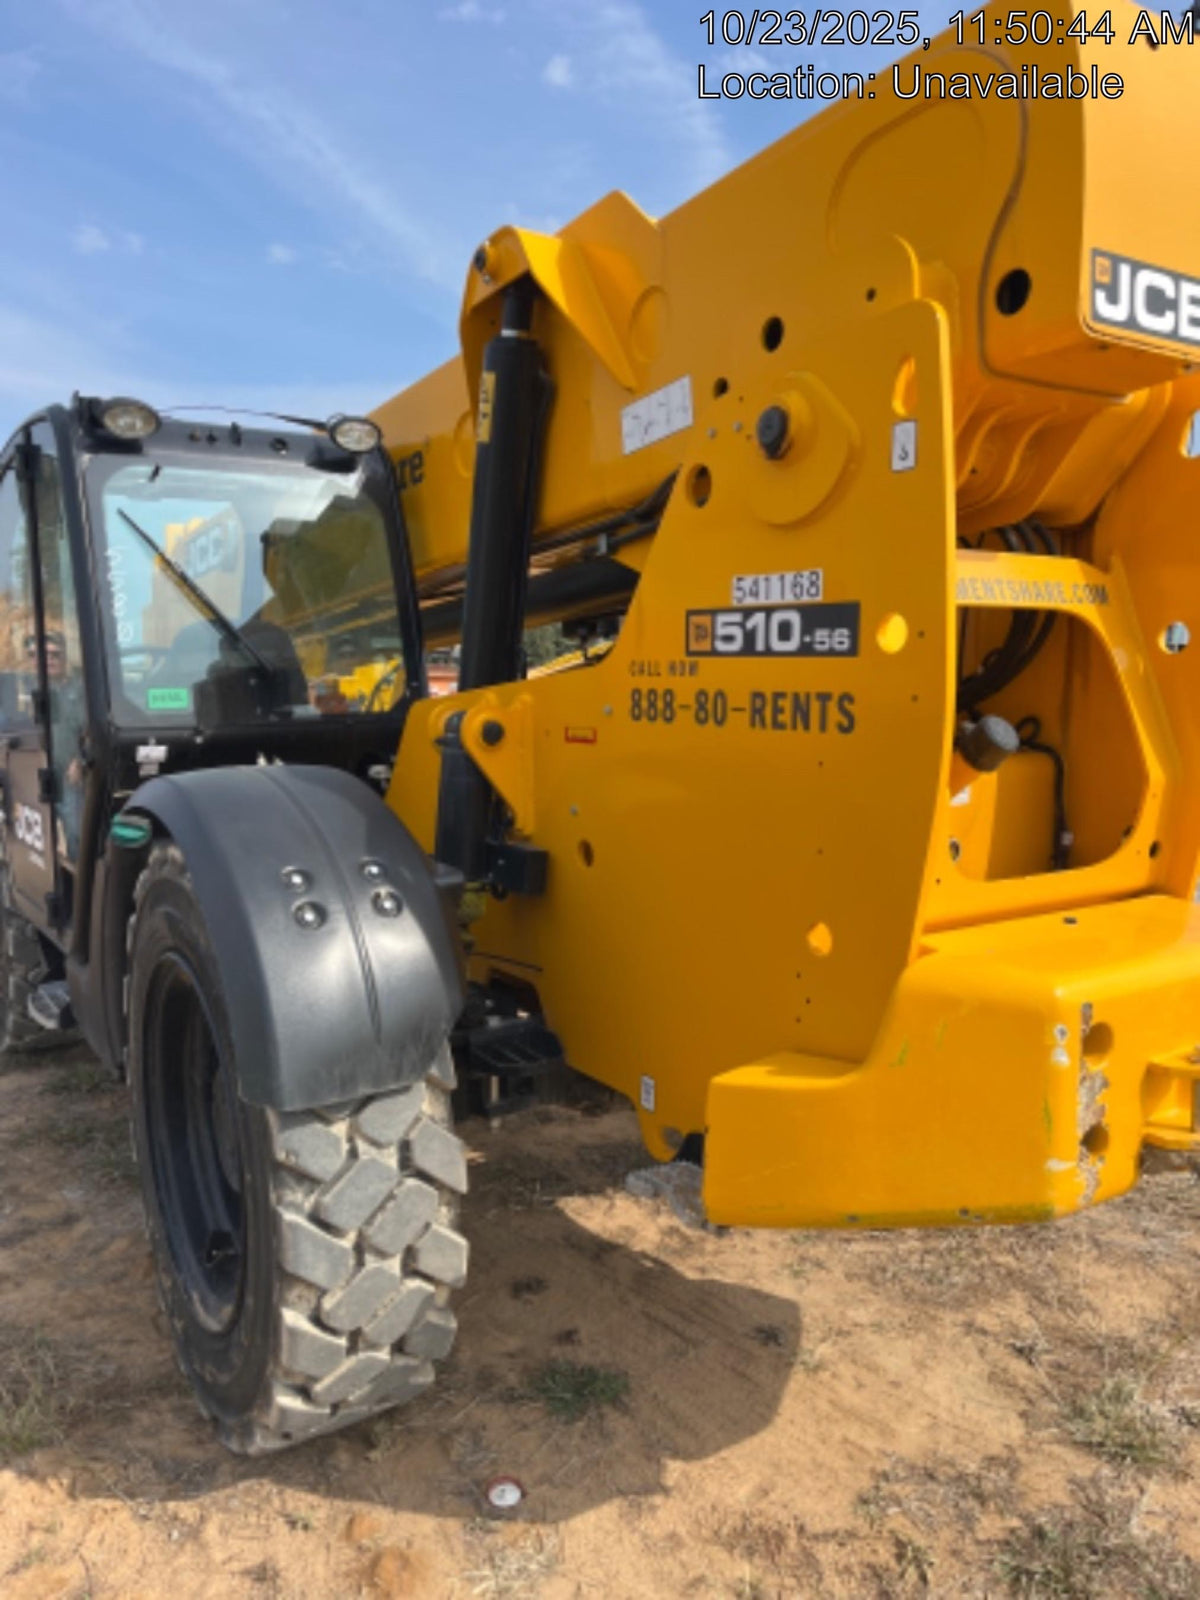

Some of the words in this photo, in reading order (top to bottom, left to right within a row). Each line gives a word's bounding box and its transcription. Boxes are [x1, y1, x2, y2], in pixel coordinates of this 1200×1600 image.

[734, 570, 821, 603] 541168
[630, 660, 662, 677] CALL
[630, 687, 856, 735] 888-80-RENTS
